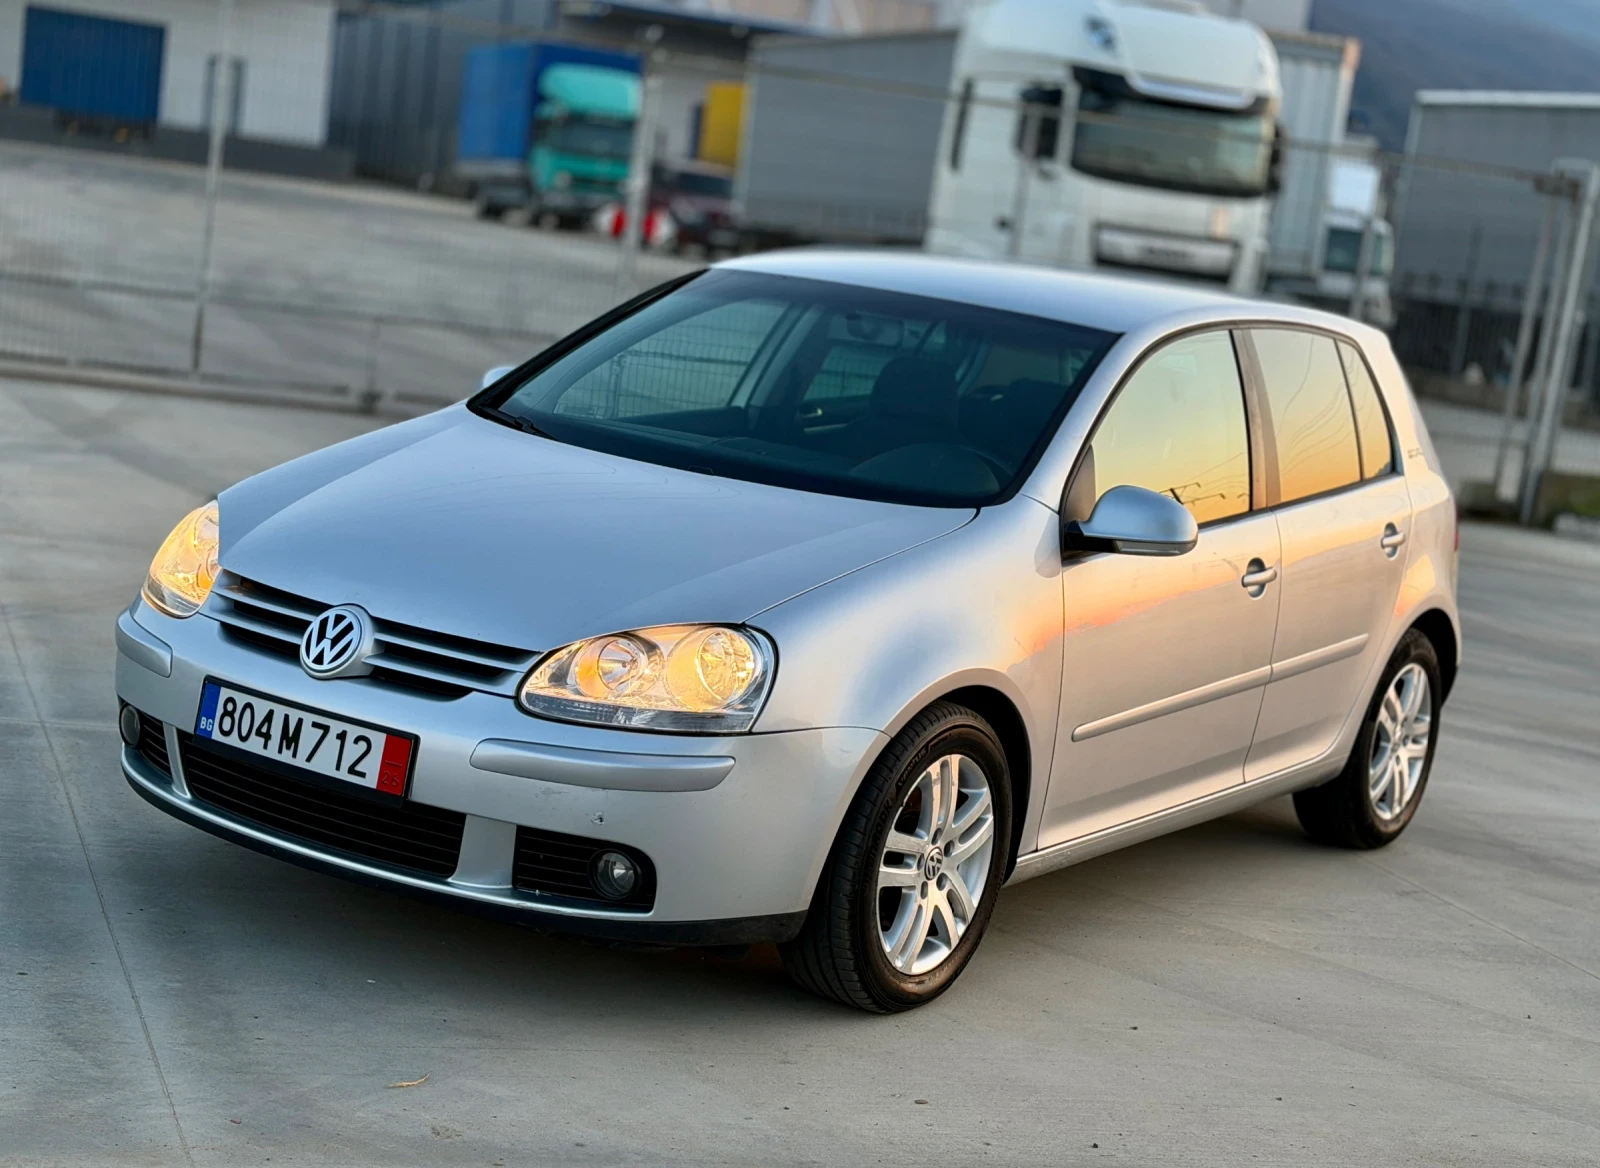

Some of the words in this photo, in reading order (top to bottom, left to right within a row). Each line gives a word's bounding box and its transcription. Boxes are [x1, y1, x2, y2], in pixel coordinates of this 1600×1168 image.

[303, 609, 361, 670] VW
[200, 716, 213, 731] BG
[218, 696, 373, 779] 804M712
[382, 770, 400, 786] 26
